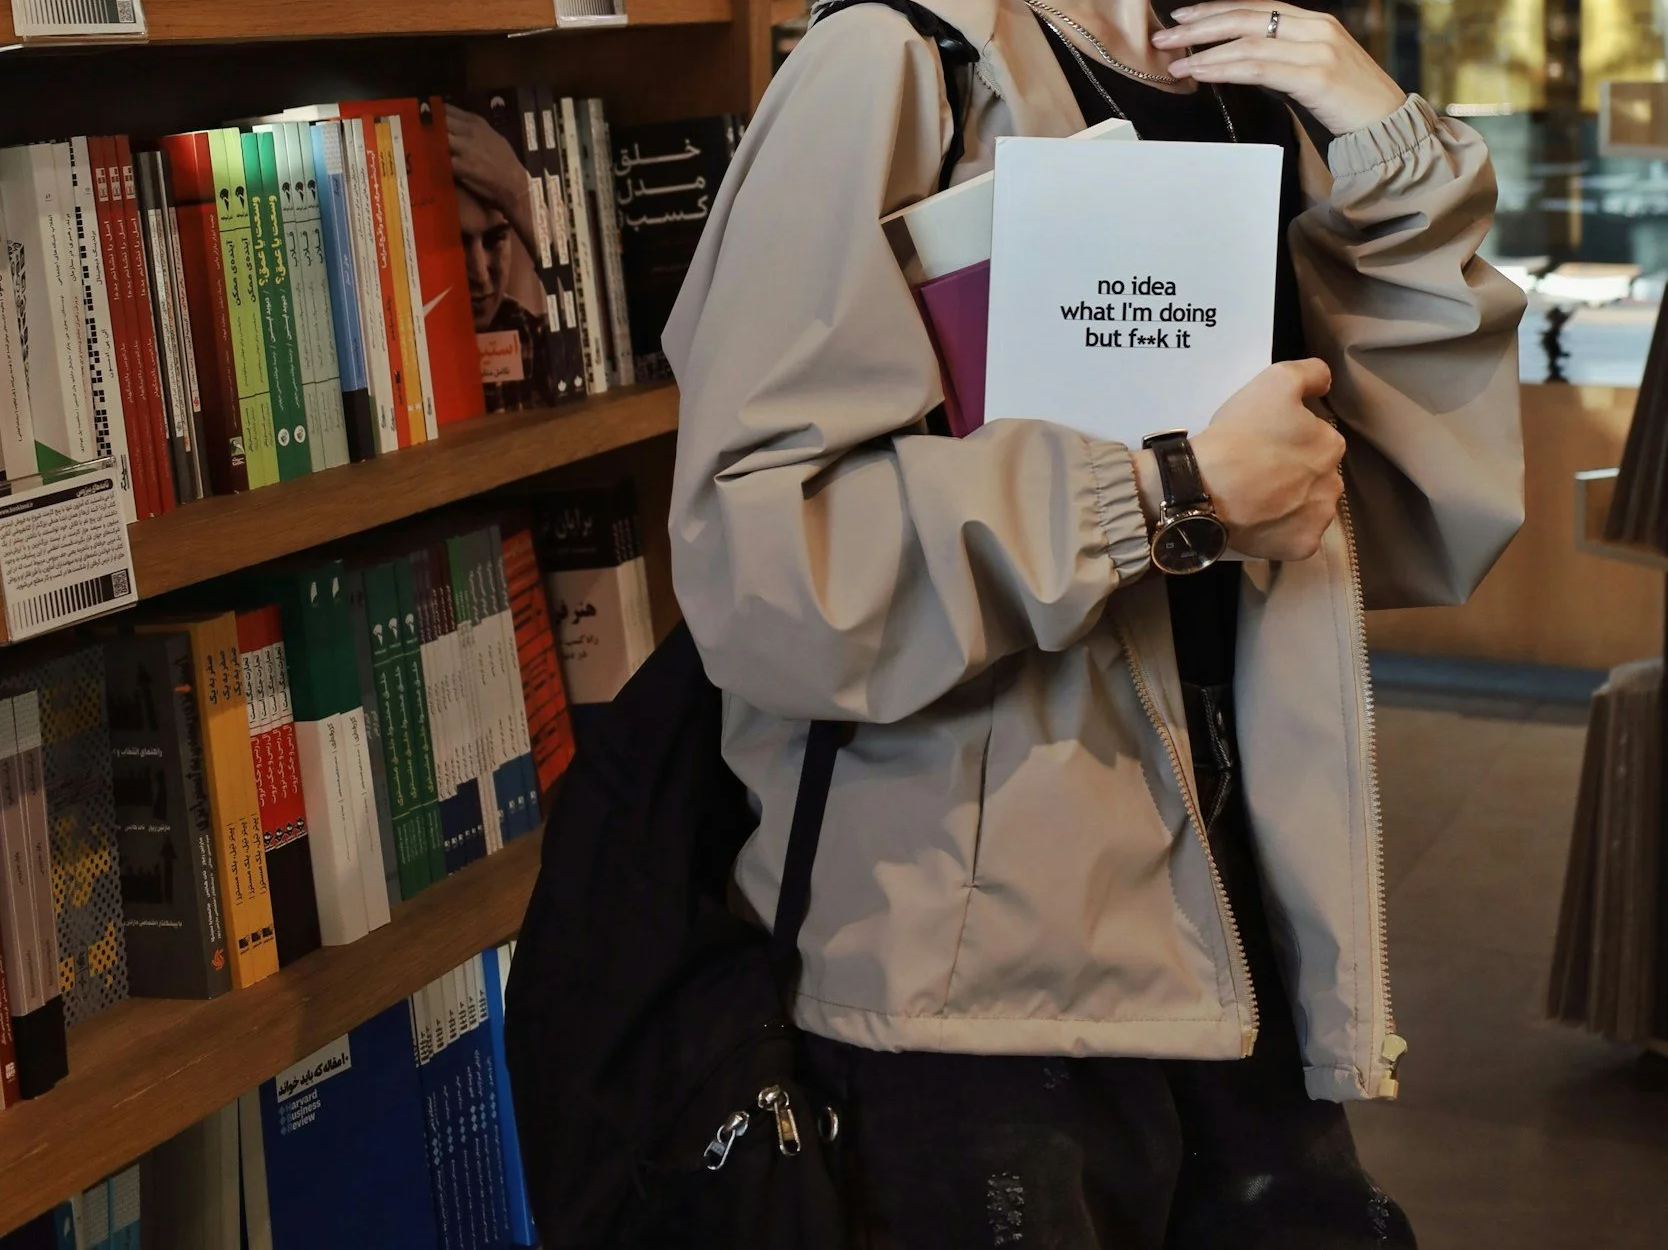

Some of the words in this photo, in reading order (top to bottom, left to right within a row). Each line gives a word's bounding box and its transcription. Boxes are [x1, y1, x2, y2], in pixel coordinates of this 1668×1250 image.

[614, 138, 702, 176] خلق
[617, 174, 707, 206] مدل
[249, 195, 264, 238] وسعت
[267, 194, 280, 236] وسعت
[626, 194, 709, 232] کسب
[254, 239, 266, 250] یا
[270, 237, 282, 248] یا
[255, 250, 270, 286] عمق؟
[271, 248, 287, 284] عمق؟
[229, 278, 242, 306] ممکن
[245, 276, 257, 302] ممکن
[1098, 279, 1124, 295] no
[1131, 276, 1176, 296] idea
[263, 296, 272, 314] دیوید
[279, 294, 289, 312] دیوید
[1060, 301, 1115, 321] what
[1122, 302, 1152, 322] I'm
[1159, 302, 1217, 327] doing
[1085, 327, 1122, 347] but
[1175, 329, 1191, 348] it
[203, 653, 216, 674] صفر
[216, 649, 228, 670] صفر
[227, 646, 239, 666] صفر
[252, 653, 263, 676] تجارت
[263, 649, 274, 671] تجارت
[219, 671, 230, 683] به
[230, 667, 241, 679] به
[242, 656, 253, 678] تجارت
[206, 674, 217, 687] به
[232, 680, 243, 696] یک
[244, 679, 255, 697] جنگ
[255, 676, 266, 695] جنگ
[266, 672, 276, 691] جنگ
[207, 688, 219, 705] یک
[220, 684, 232, 700] یک
[314, 1062, 322, 1077] که
[324, 1057, 342, 1072] مقاله
[278, 1076, 298, 1095] خواند
[300, 1070, 313, 1085] باید
[286, 1088, 318, 1112] Harvard
[287, 1099, 322, 1123] Business
[287, 1112, 316, 1133] Review
